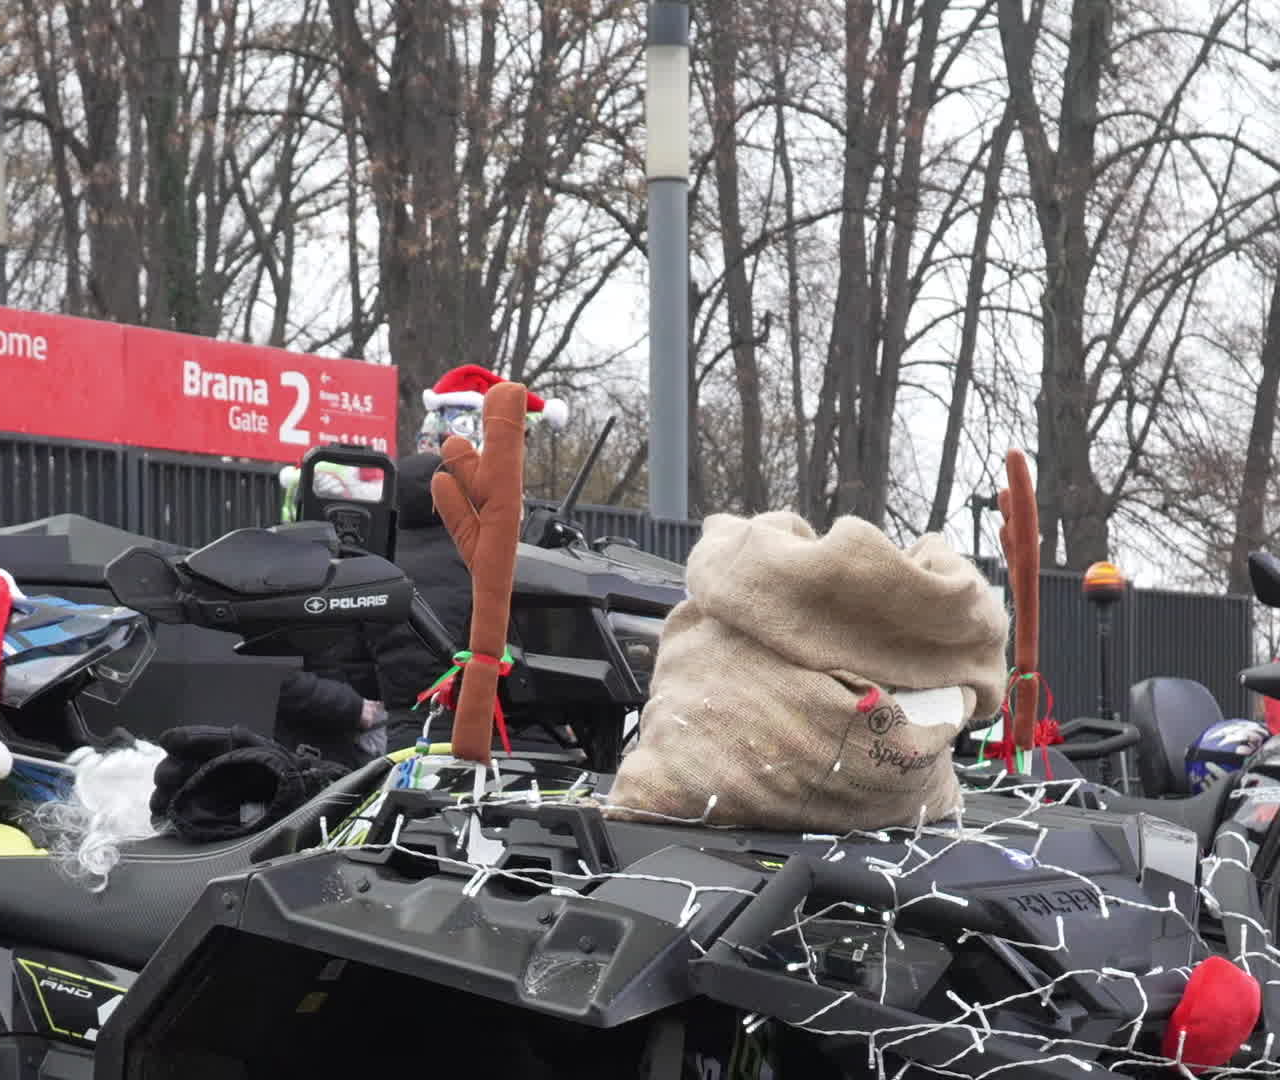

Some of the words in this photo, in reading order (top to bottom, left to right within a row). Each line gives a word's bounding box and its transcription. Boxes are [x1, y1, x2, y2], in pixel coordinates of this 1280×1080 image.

[183, 360, 269, 406] Brama
[228, 406, 268, 433] Gate
[279, 371, 311, 445] 2
[330, 595, 389, 610] POLARIS
[40, 979, 93, 999] AWD
